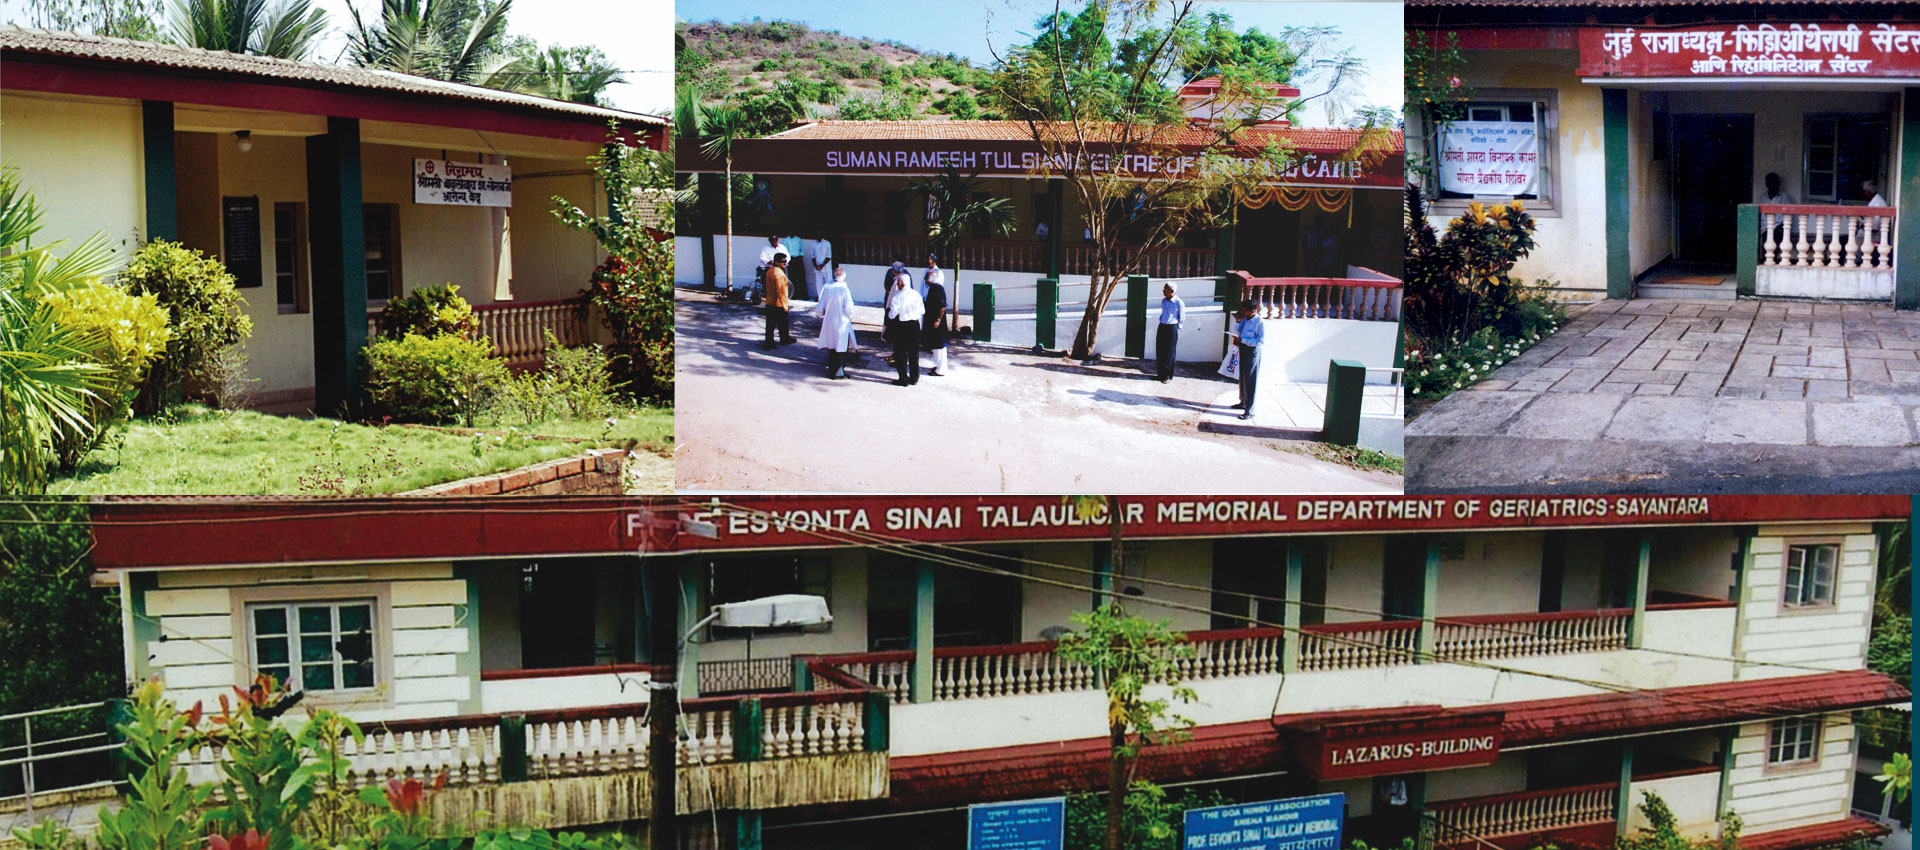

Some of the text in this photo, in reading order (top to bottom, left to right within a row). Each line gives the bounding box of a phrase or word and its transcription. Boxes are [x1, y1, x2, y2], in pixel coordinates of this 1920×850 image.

[1603, 28, 1635, 60] जुई
[1690, 55, 1728, 74] आणि
[1828, 54, 1873, 74] सेंटर
[826, 151, 891, 168] SUMAN
[895, 151, 976, 168] RAMESH
[1445, 146, 1464, 163] श्रीमती
[1466, 151, 1485, 163] शारदा
[1489, 148, 1515, 163] विनायक
[728, 508, 871, 534] ESVONTA
[886, 507, 961, 531] SINAI
[1157, 501, 1288, 523] MEMORIAL
[1298, 500, 1446, 521] DEPARTMENT
[1454, 500, 1480, 518] OF
[1332, 736, 1494, 766] LAZARUS-BUILDING
[1201, 798, 1331, 820] THE GOA HINDU ASSOCIATION
